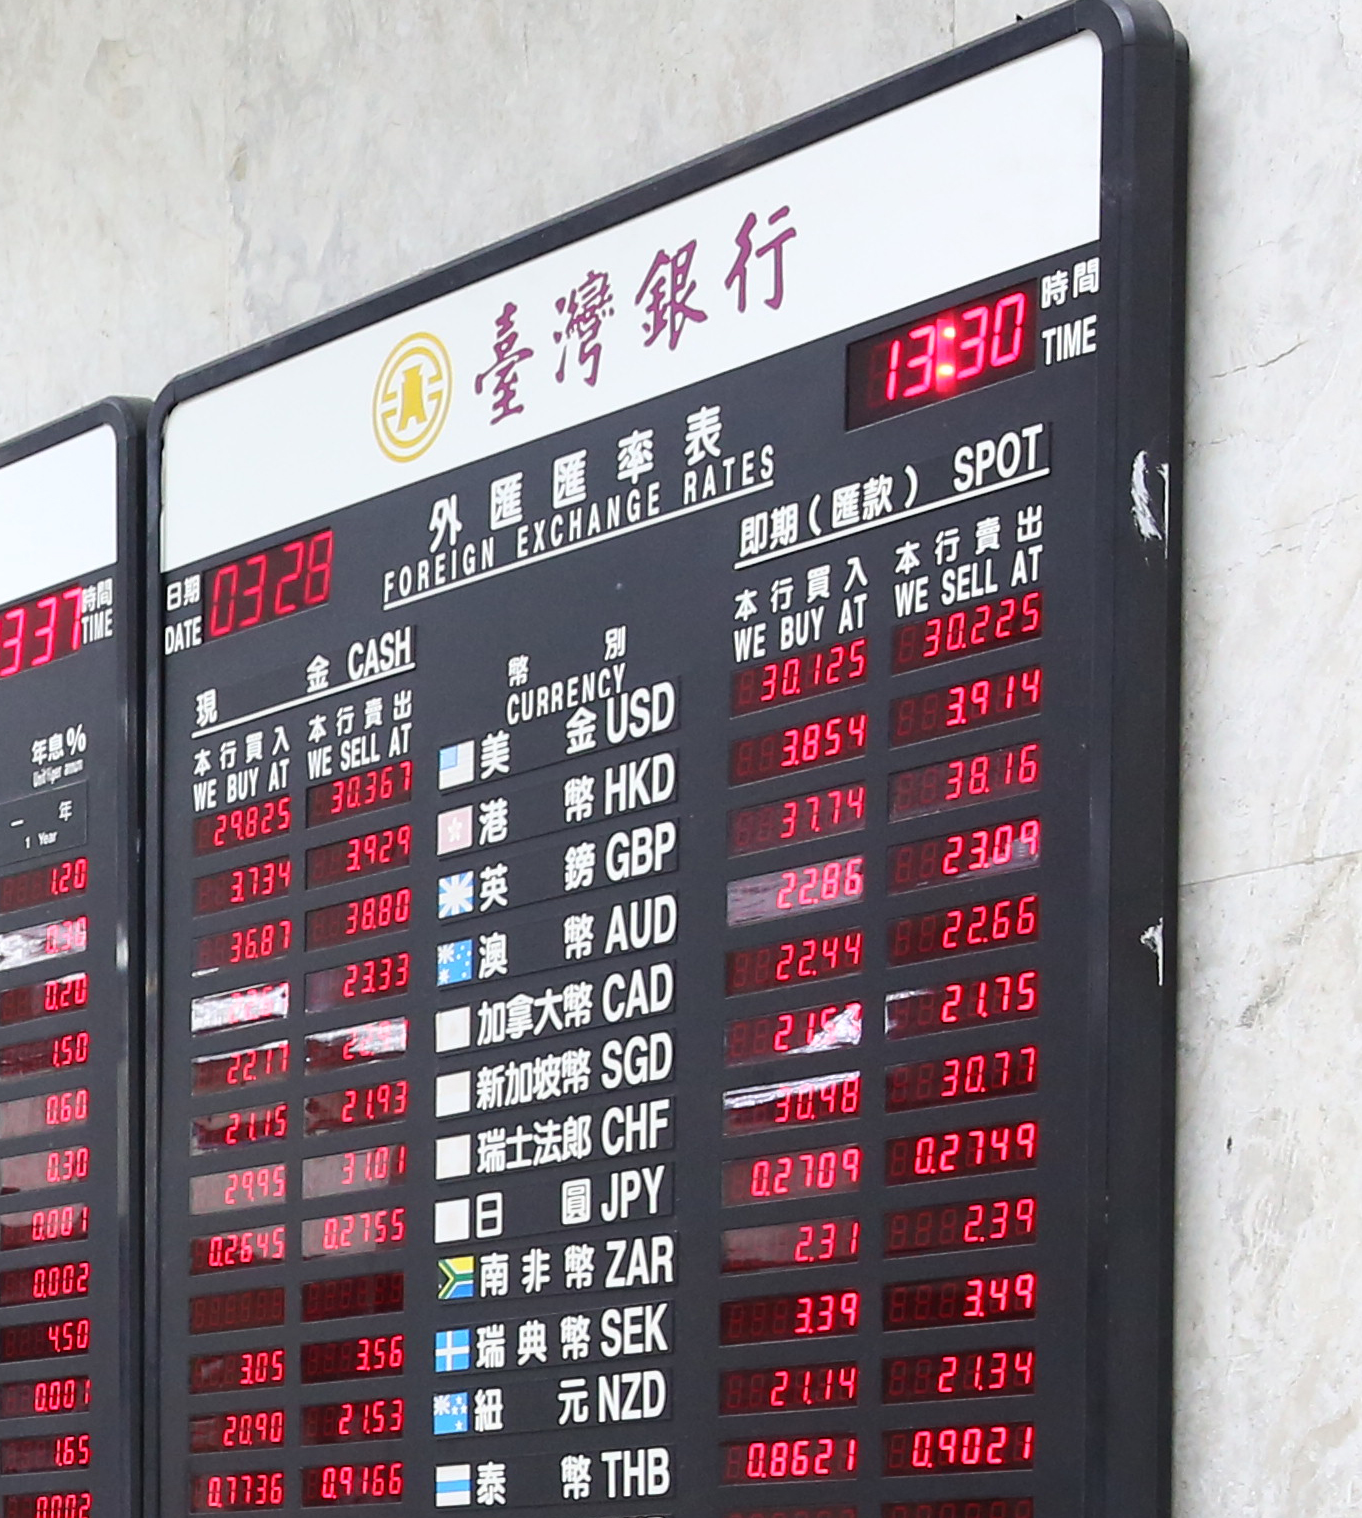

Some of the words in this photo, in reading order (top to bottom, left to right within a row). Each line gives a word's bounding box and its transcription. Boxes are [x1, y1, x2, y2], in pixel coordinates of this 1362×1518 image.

[1040, 256, 1101, 310] 時間
[475, 205, 796, 425] 臺灣銀行
[1041, 313, 1098, 367] TIME
[428, 403, 723, 553] 外匯匯率表
[952, 422, 1045, 493] SPOT
[383, 536, 495, 604] FOREIGN
[517, 480, 662, 560] EXCHANGE
[683, 443, 776, 505] RATES
[893, 504, 1044, 575] 本行賣出
[81, 577, 114, 614] 時間
[166, 573, 201, 612] 日期
[733, 556, 869, 622] 本行買入
[894, 574, 929, 618] WE
[940, 558, 999, 606] SELL
[1010, 544, 1044, 588] AT
[81, 607, 114, 645] TIME
[165, 615, 203, 656] DATE
[347, 625, 412, 681] CASH
[733, 622, 767, 663] WE
[779, 605, 825, 651] BUY
[837, 592, 869, 635] AT
[307, 689, 413, 744] 本行賣出
[506, 662, 627, 726] CURRENCY
[604, 680, 676, 745] USD
[192, 725, 291, 777] 本行買入
[307, 745, 333, 780] WE
[340, 732, 381, 772] SELL
[388, 722, 413, 758] AT
[192, 778, 217, 812] WE
[226, 768, 260, 805] BUY
[268, 757, 291, 793] AT
[604, 752, 676, 816] HKD
[604, 820, 677, 883] GBP
[604, 893, 678, 956] AUD
[476, 981, 594, 1047] 加拿大幣
[602, 961, 675, 1024] CAD
[475, 1047, 592, 1112] 新加坡幣
[600, 1031, 674, 1090] SGD
[476, 1113, 593, 1176] 瑞士法郎
[601, 1098, 671, 1158] CHF
[600, 1164, 666, 1223] JPY
[479, 1243, 596, 1299] 南非幣
[604, 1234, 675, 1289] ZAR
[475, 1314, 592, 1369] 瑞典幣
[600, 1302, 669, 1358] SEK
[597, 1369, 667, 1423] NZD
[600, 1447, 671, 1499] THB
